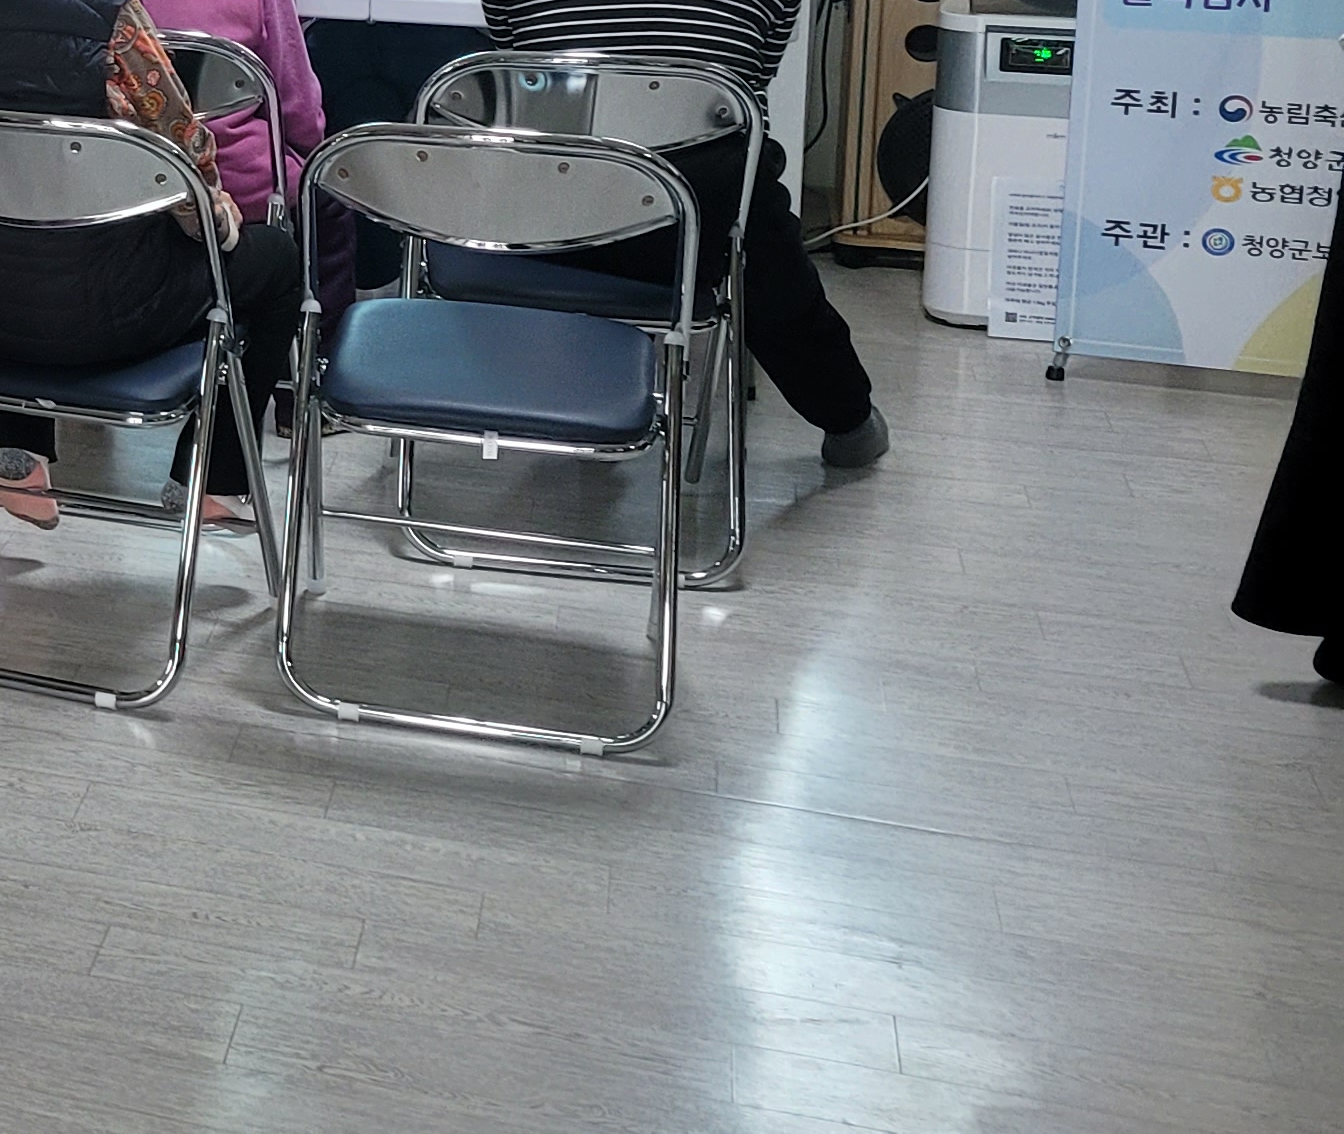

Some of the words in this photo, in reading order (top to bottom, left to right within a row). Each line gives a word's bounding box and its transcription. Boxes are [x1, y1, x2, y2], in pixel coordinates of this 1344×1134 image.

[1111, 88, 1178, 120] 주최
[1259, 100, 1344, 128] 농림축
[1268, 145, 1344, 172] 청양군
[1250, 181, 1333, 208] 농협청
[1100, 219, 1171, 251] 주관
